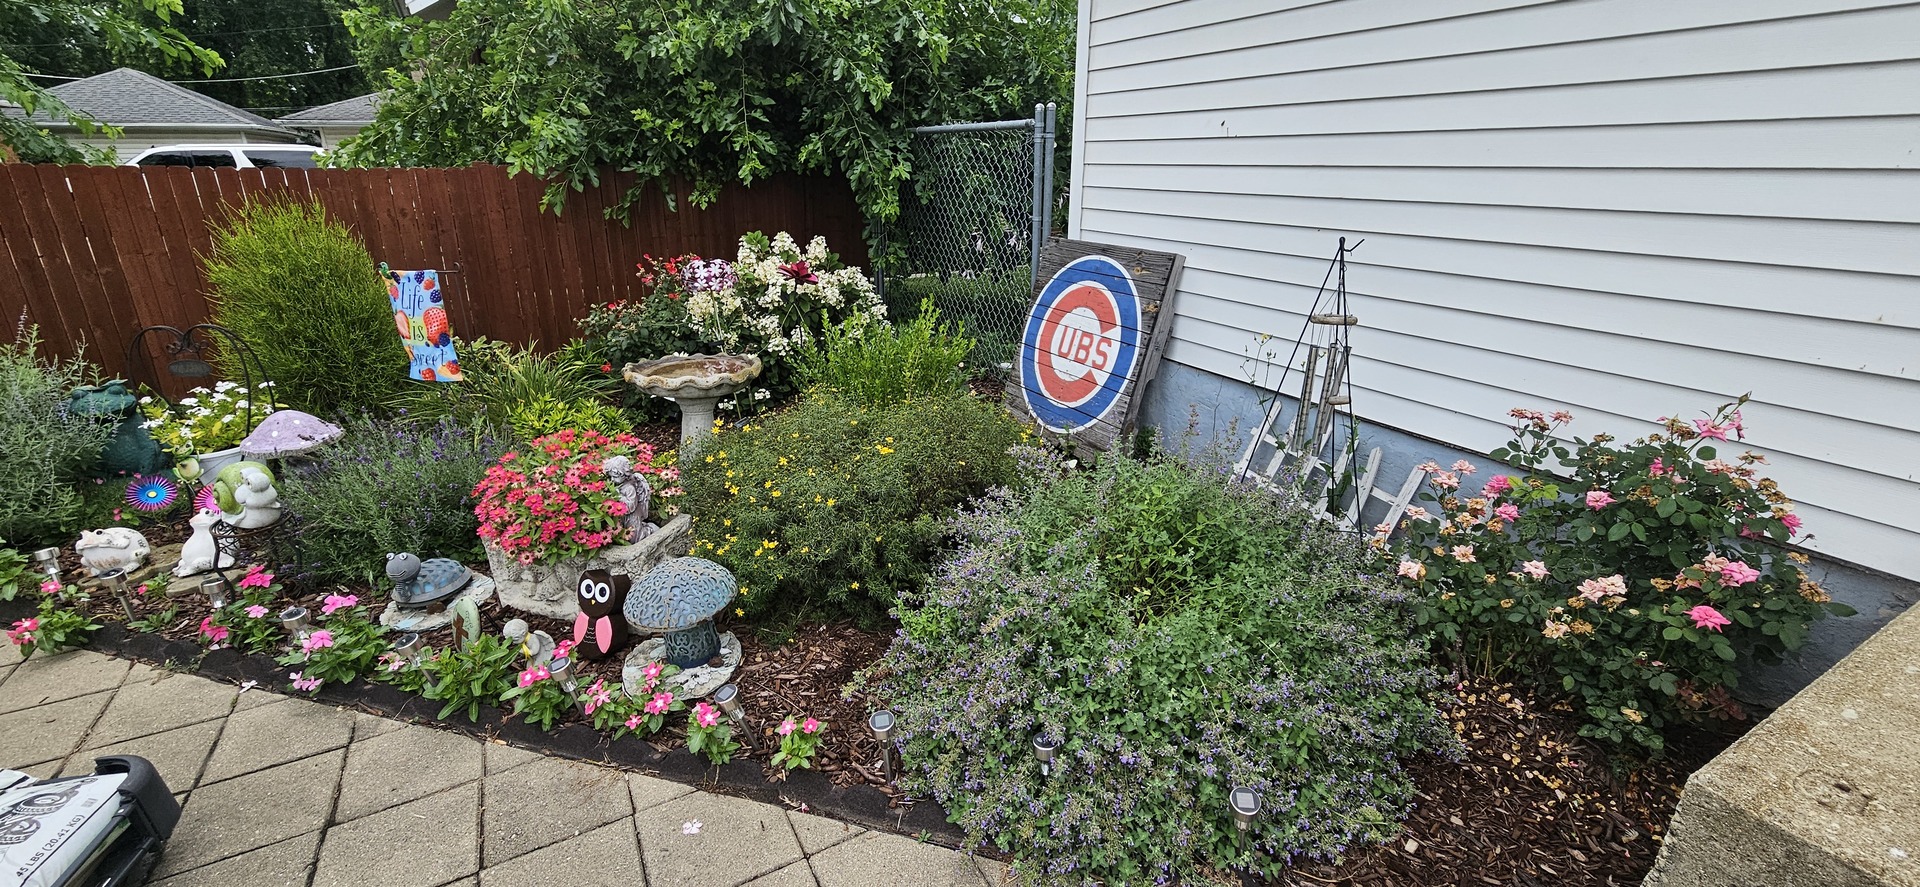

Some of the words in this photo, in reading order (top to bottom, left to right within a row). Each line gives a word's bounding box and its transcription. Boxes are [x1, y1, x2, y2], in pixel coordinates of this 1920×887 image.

[401, 282, 424, 319] Life
[412, 320, 425, 342] is
[16, 867, 29, 878] 45
[27, 851, 45, 867] LBS
[42, 828, 70, 852] (20.41
[67, 814, 86, 828] KG)
